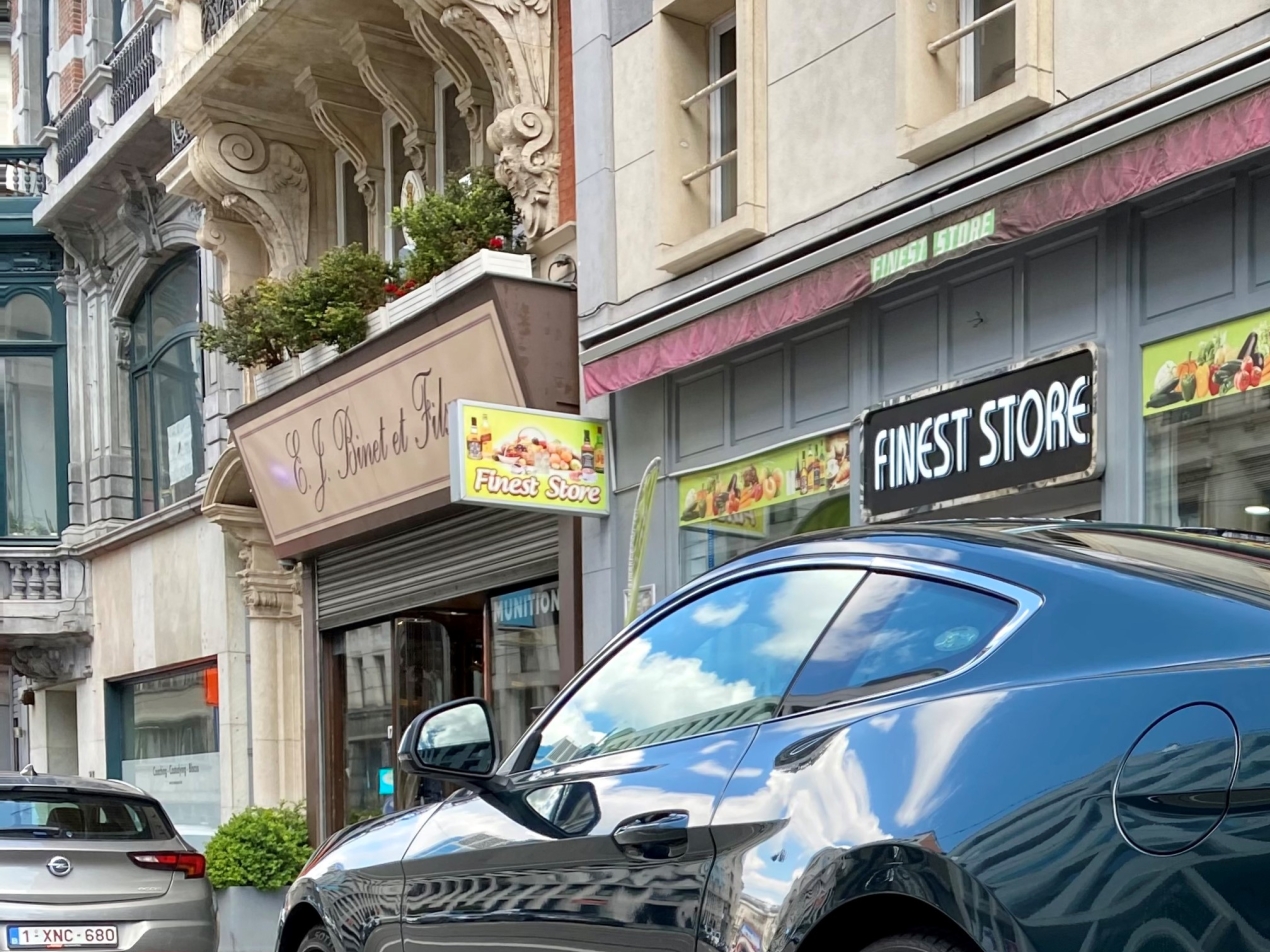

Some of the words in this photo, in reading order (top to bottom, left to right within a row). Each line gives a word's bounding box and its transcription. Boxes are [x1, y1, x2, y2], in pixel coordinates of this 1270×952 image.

[871, 235, 928, 283] FINEST
[934, 208, 994, 257] STORE
[332, 406, 388, 480] Binet
[392, 407, 409, 456] et
[874, 407, 973, 491] FINEST
[979, 375, 1090, 468] STORE
[474, 467, 540, 498] Finest
[545, 474, 601, 504] Store
